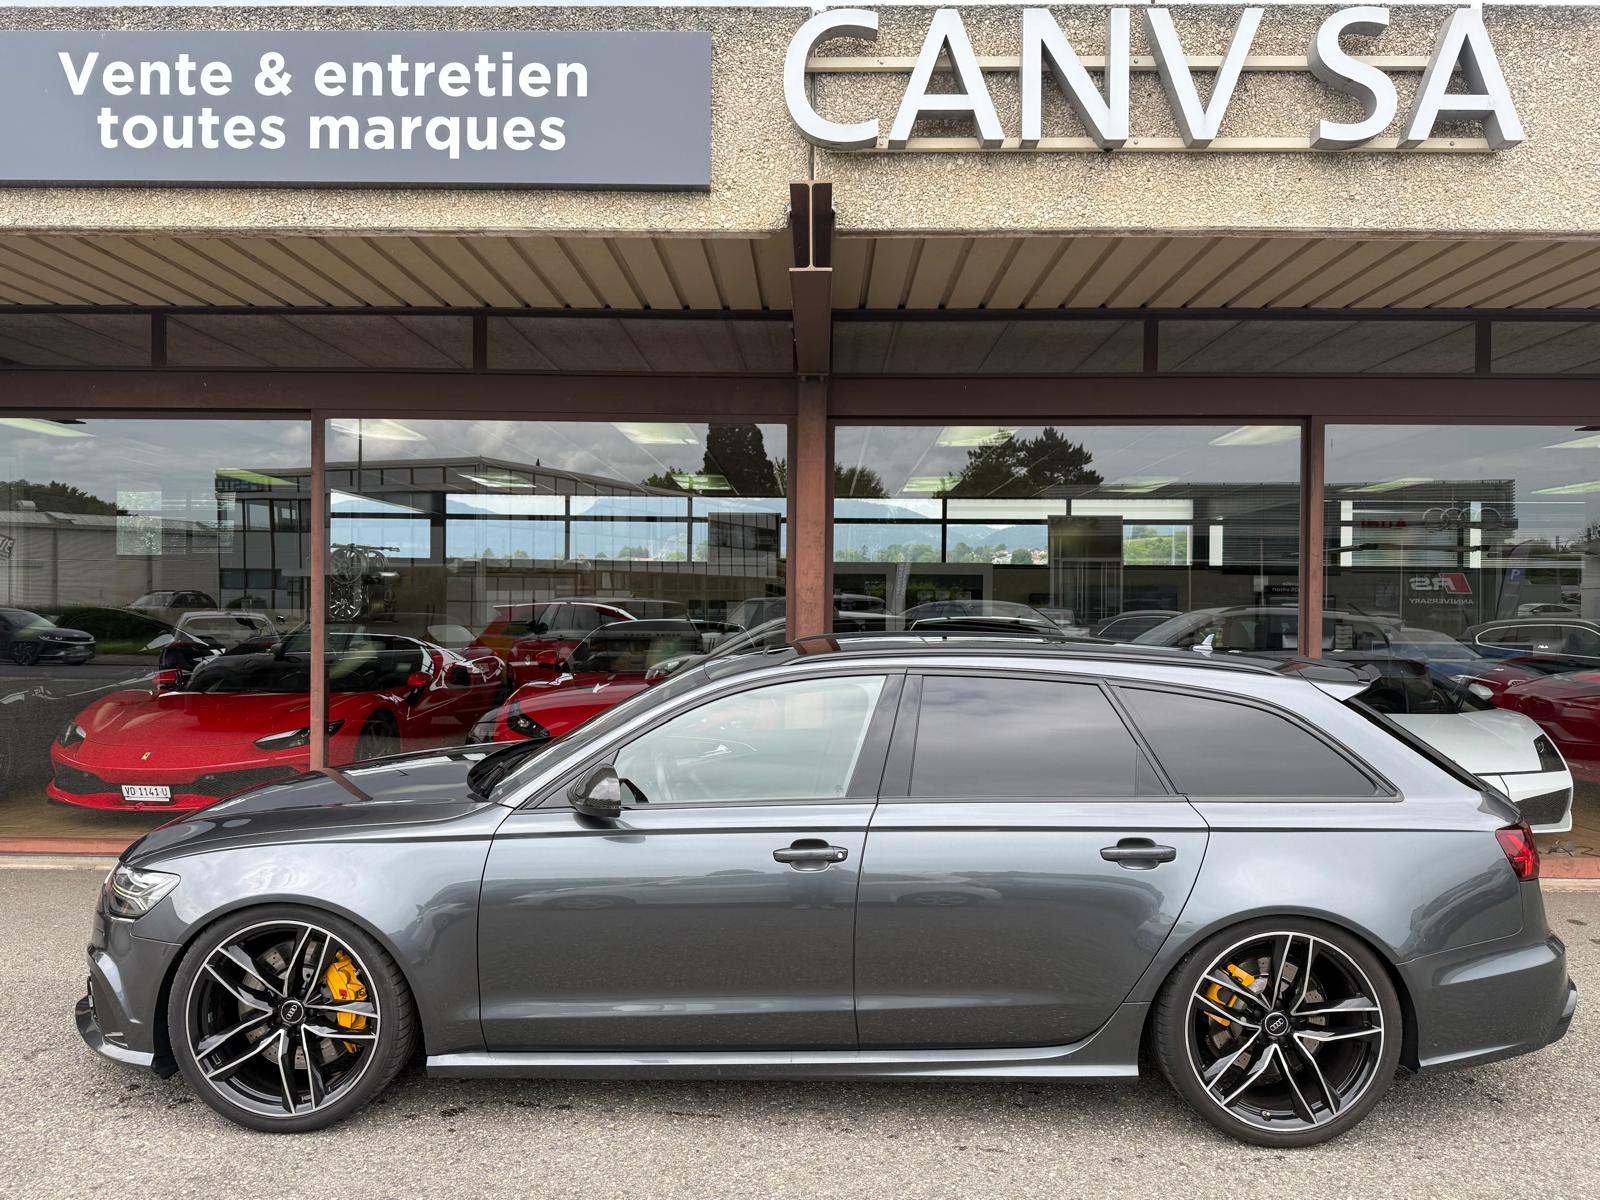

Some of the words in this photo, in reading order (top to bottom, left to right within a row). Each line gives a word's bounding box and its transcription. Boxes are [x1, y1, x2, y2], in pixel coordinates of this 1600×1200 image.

[58, 52, 232, 95] Vente
[255, 52, 292, 96] &
[315, 52, 587, 97] entretien
[783, 7, 1263, 150] CANV
[1308, 6, 1525, 150] SA
[97, 108, 285, 149] toutes
[310, 116, 565, 159] marques
[125, 787, 136, 795] VD
[139, 788, 159, 796] 1141
[162, 788, 168, 796] U
